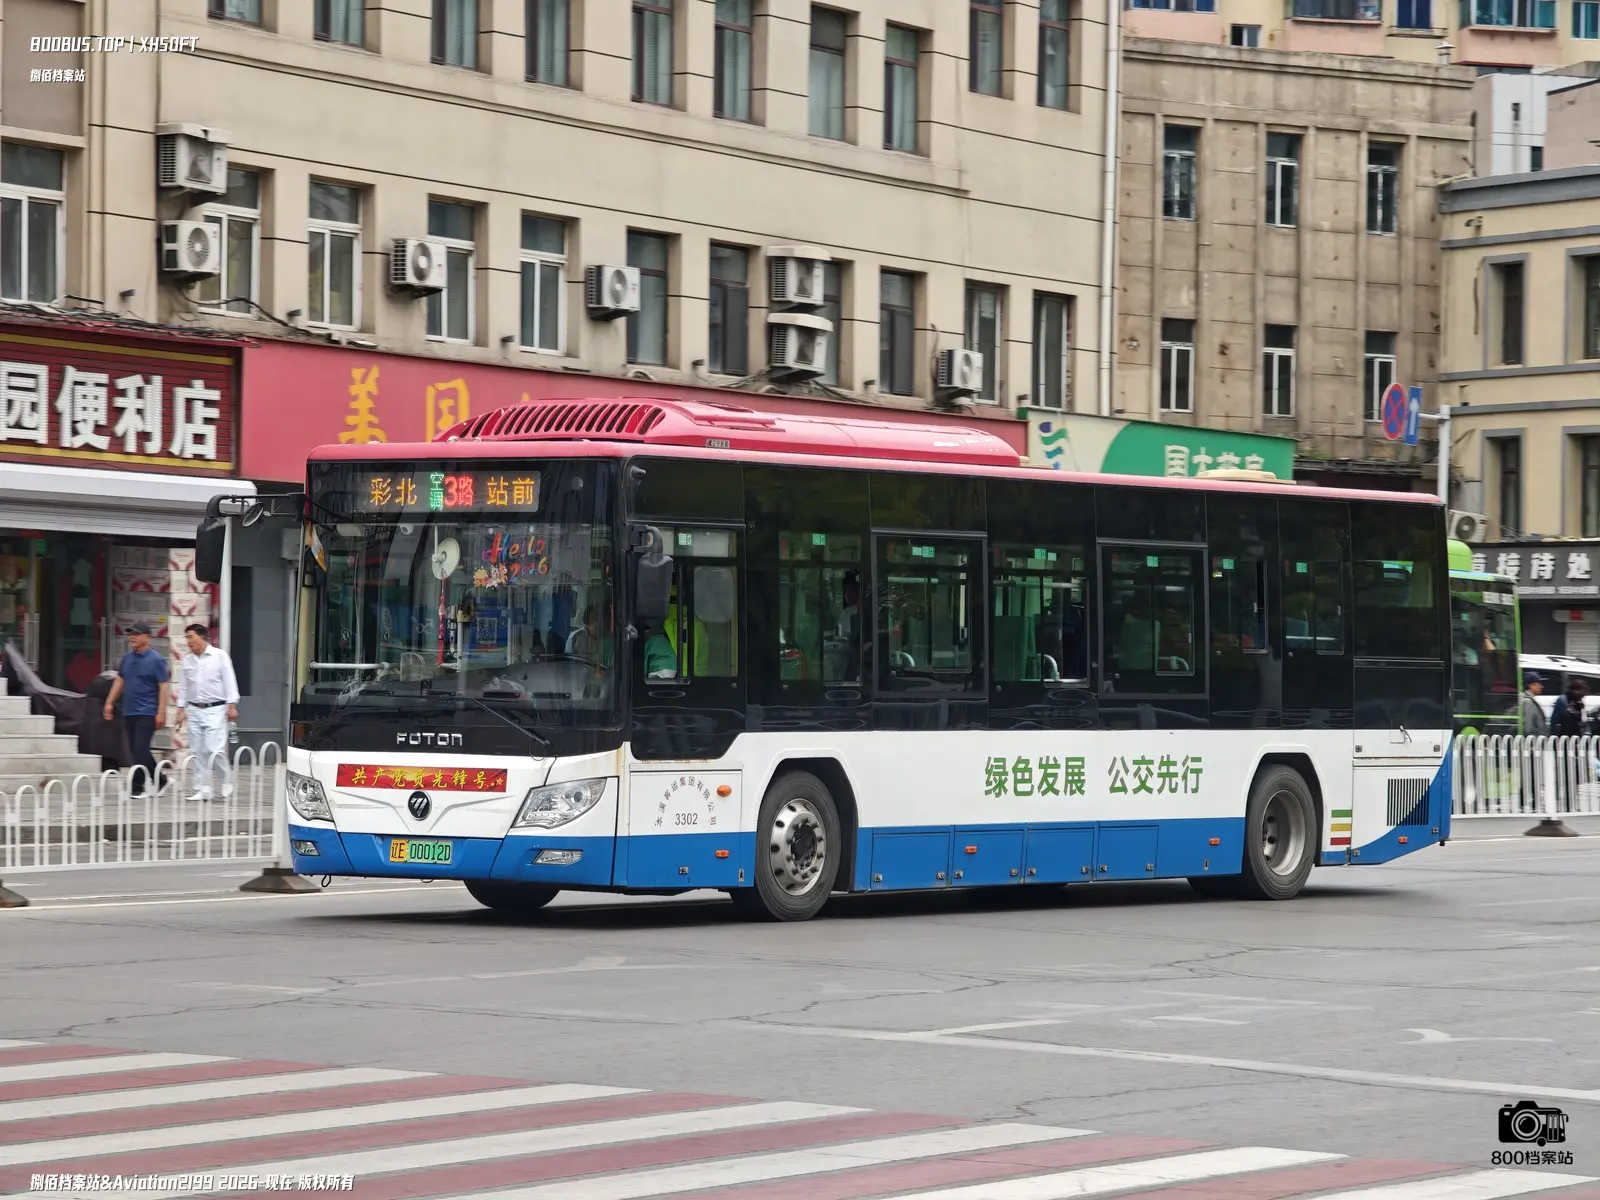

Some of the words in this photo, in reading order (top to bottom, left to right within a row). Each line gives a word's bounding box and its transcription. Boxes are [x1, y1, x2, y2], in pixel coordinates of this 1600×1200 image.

[0, 361, 221, 460] 园便利店
[338, 364, 530, 443] 美国
[370, 478, 418, 506] 彩北
[429, 472, 444, 510] 空调
[444, 475, 473, 507] 3路
[487, 477, 535, 506] 站前
[396, 732, 463, 746] FOTON
[352, 766, 487, 790] 共产党员先锋号
[984, 755, 1086, 798] 绿色发展
[1107, 754, 1203, 794] 公交先行
[675, 812, 698, 826] 3302
